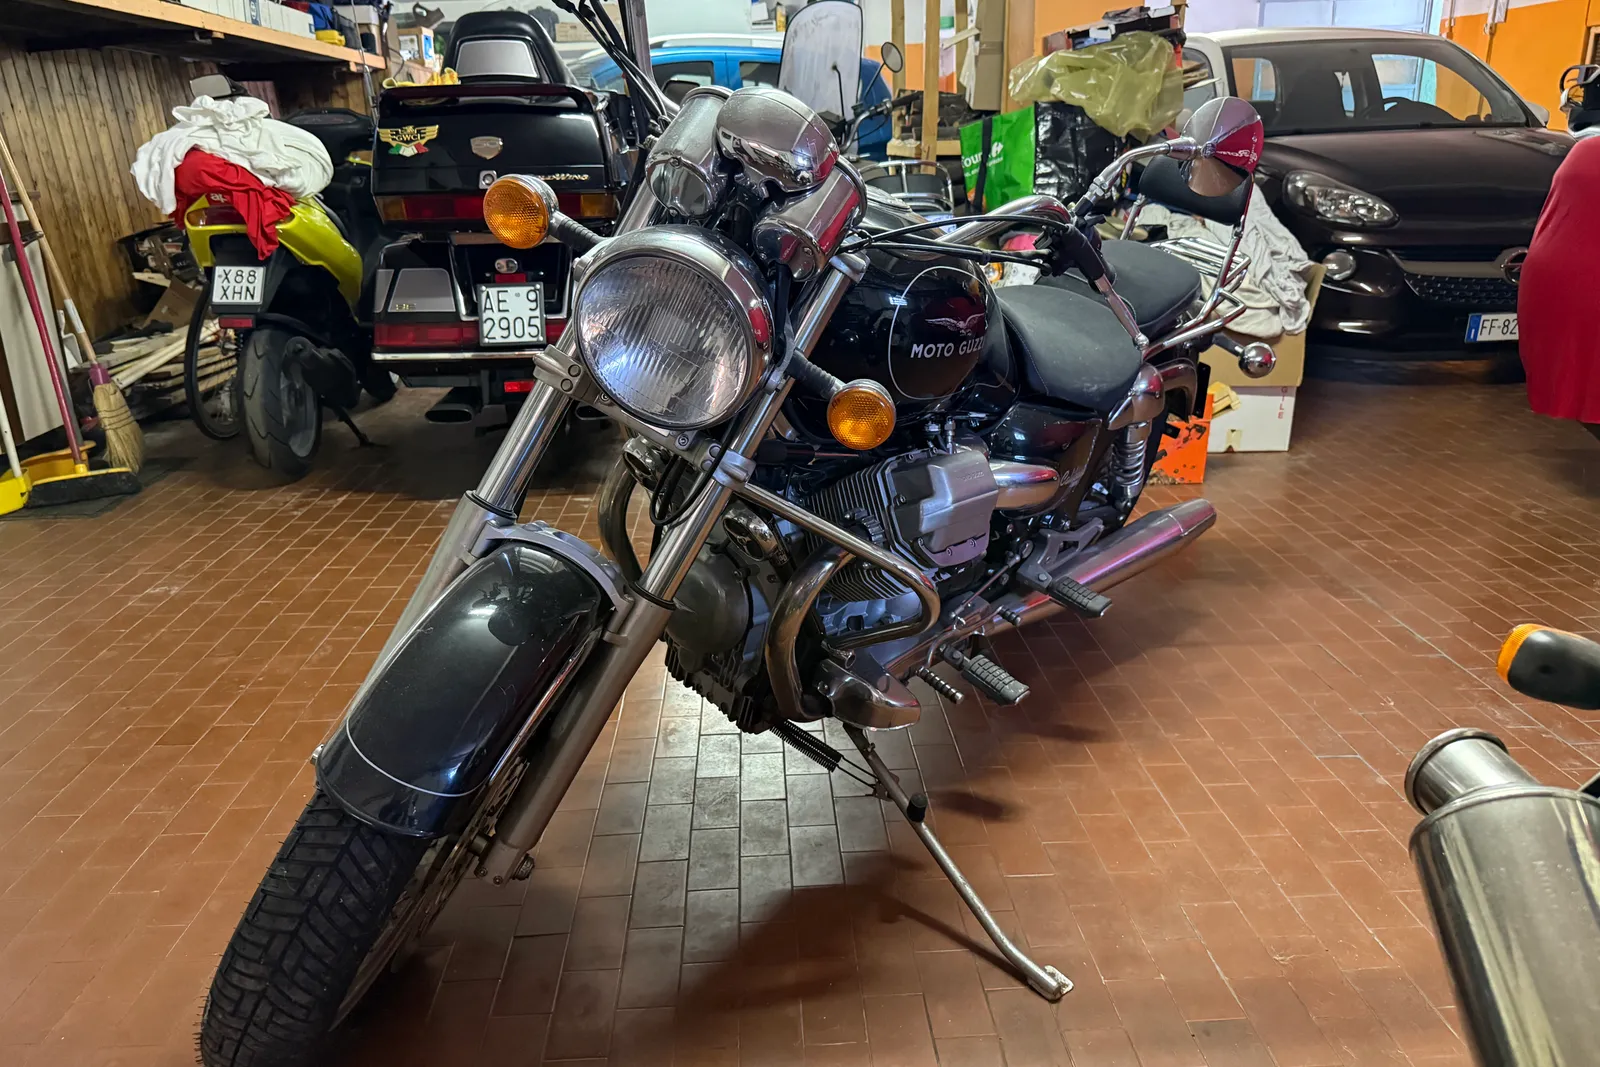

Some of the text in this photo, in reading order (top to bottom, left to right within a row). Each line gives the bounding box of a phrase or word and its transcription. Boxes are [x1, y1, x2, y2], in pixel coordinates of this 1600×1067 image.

[221, 269, 257, 284] X88
[220, 285, 256, 301] XHN
[483, 289, 539, 313] AE 9
[484, 316, 540, 340] 2905
[910, 343, 955, 359] MOTO
